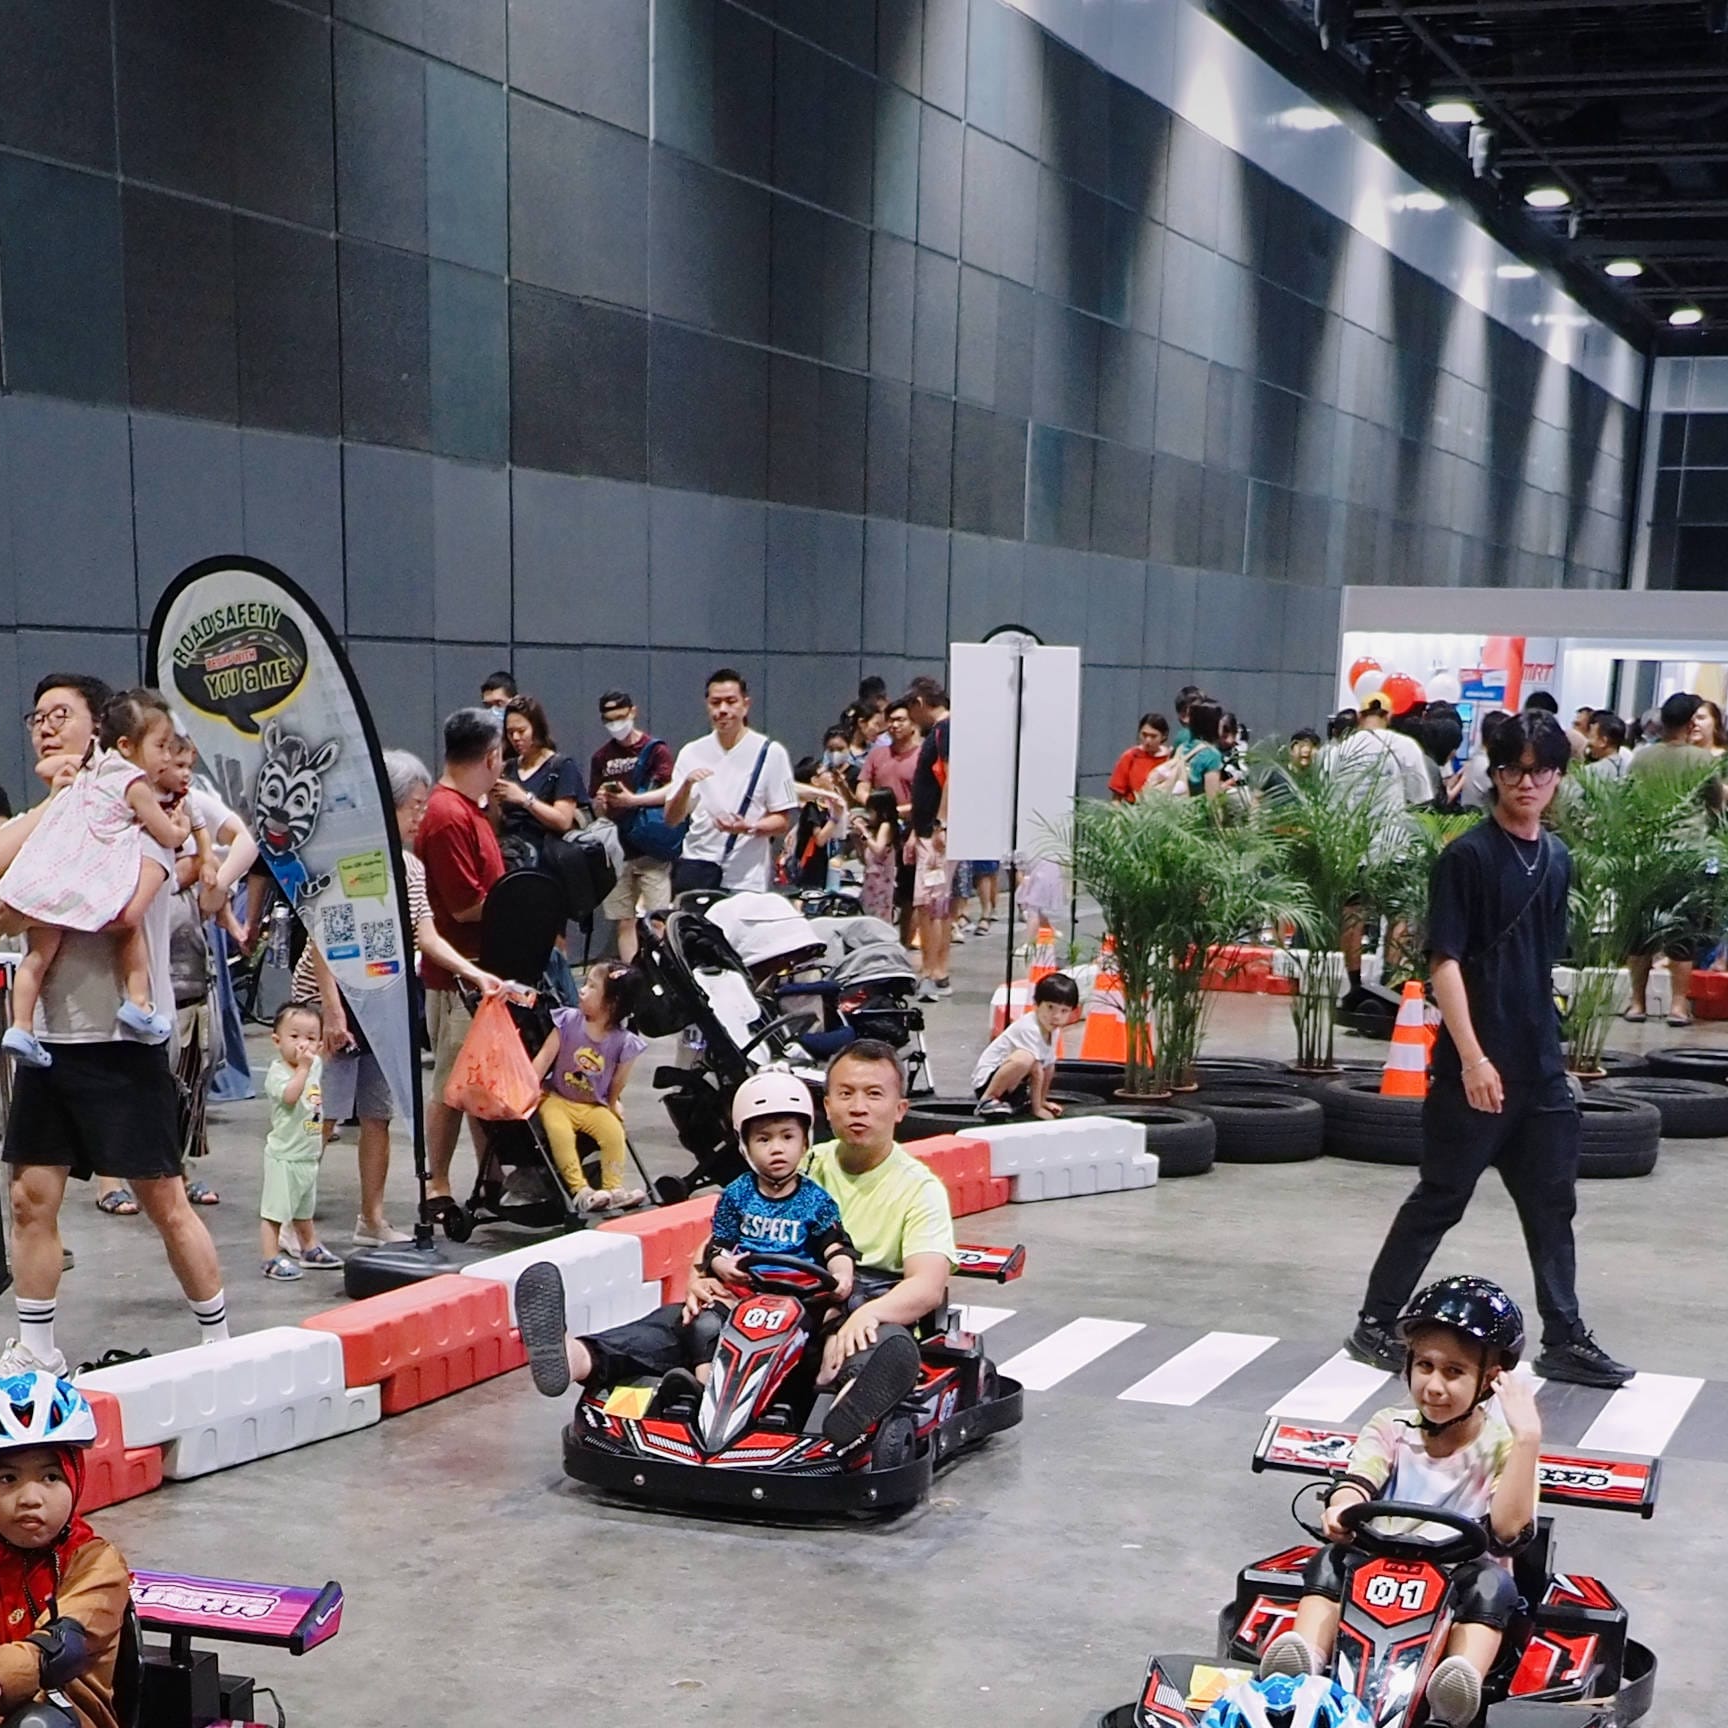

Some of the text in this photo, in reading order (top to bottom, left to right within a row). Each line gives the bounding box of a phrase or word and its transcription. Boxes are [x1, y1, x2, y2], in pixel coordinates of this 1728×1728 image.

[173, 601, 282, 669] ROAD SAFETY
[204, 659, 291, 699] YOU & ME
[1365, 1574, 1428, 1611] 01
